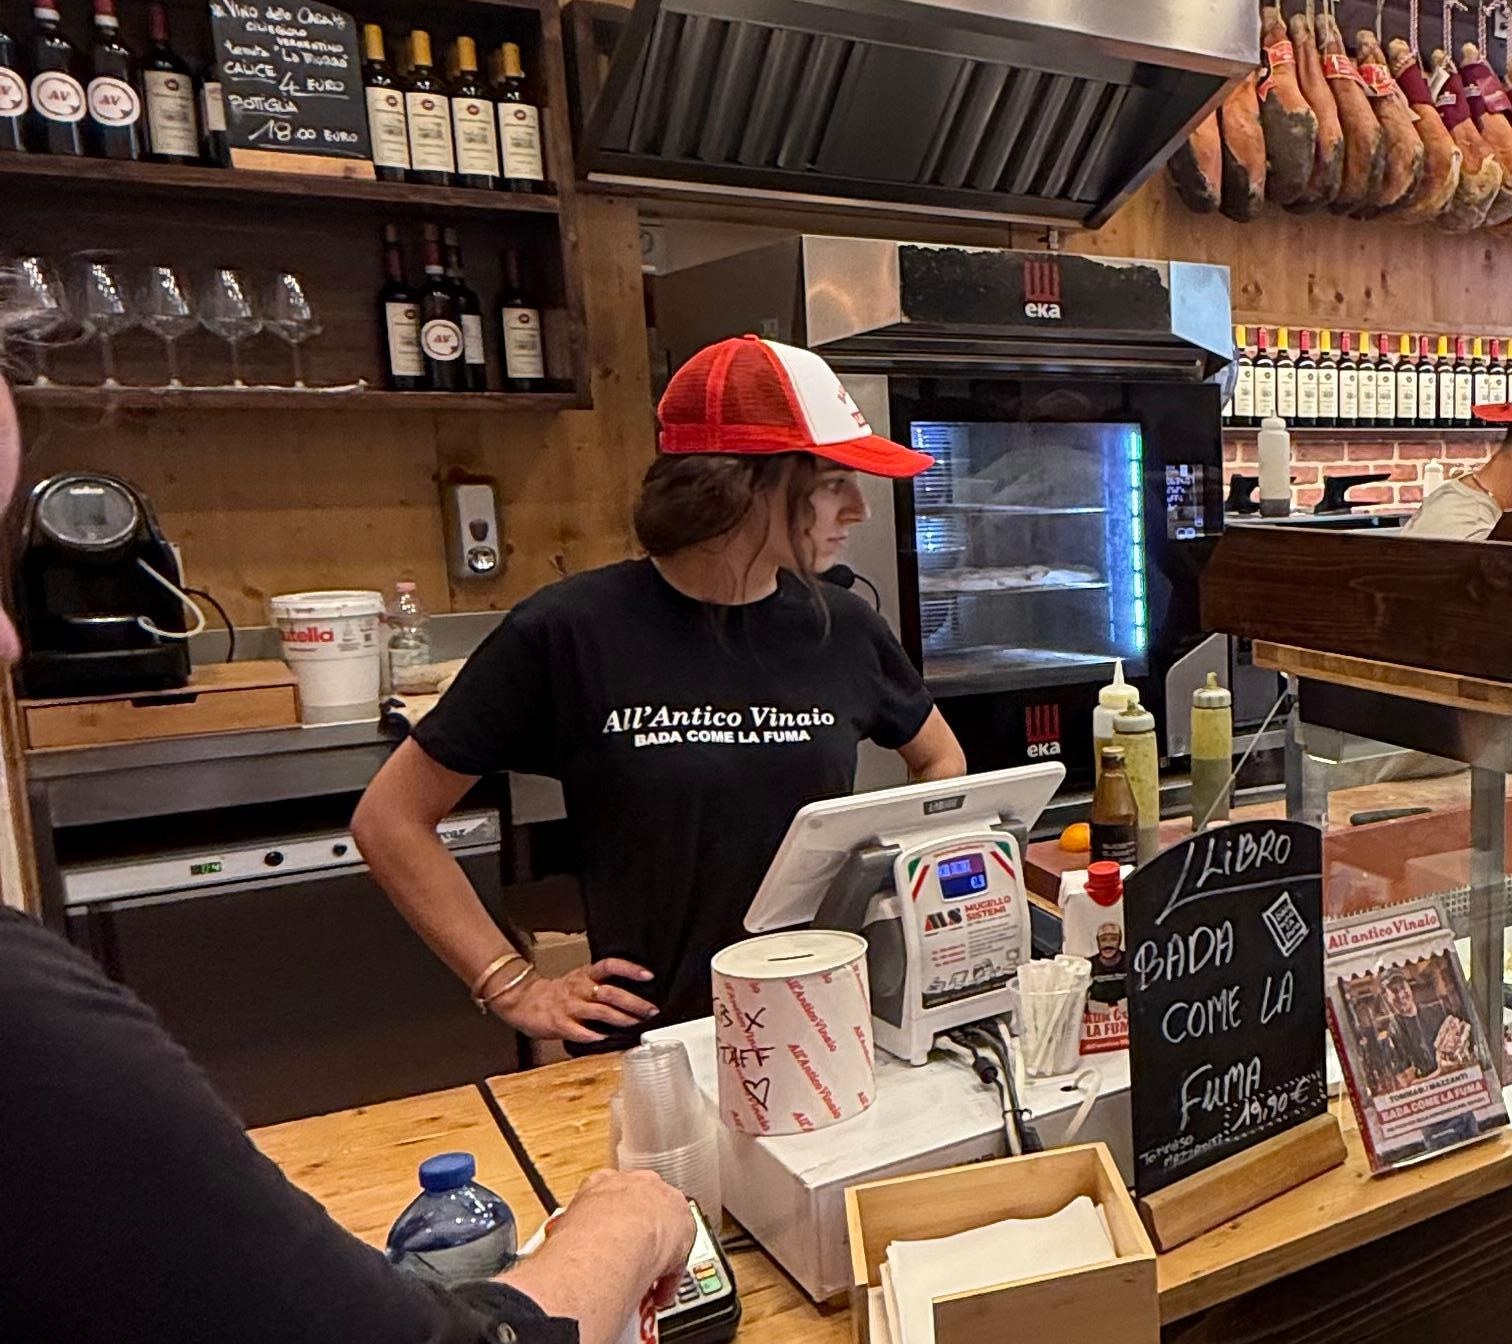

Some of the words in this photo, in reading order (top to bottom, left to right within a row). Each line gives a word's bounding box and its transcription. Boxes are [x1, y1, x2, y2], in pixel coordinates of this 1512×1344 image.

[307, 78, 345, 91] EURO
[324, 131, 358, 143] EURO
[1024, 302, 1062, 319] eka
[603, 706, 742, 733] All'Antico
[750, 706, 834, 728] Vinaio
[634, 731, 683, 748] BADA
[686, 729, 735, 744] COME
[738, 730, 760, 744] LA
[764, 729, 811, 743] FUMA
[1027, 741, 1061, 757] eka
[965, 895, 1012, 912] MUGELLO
[966, 906, 1006, 921] SISTEMI
[1134, 920, 1234, 990] BADA
[1162, 986, 1242, 1044] COME
[1260, 971, 1294, 1024] LA
[1180, 1057, 1262, 1131] FUMA
